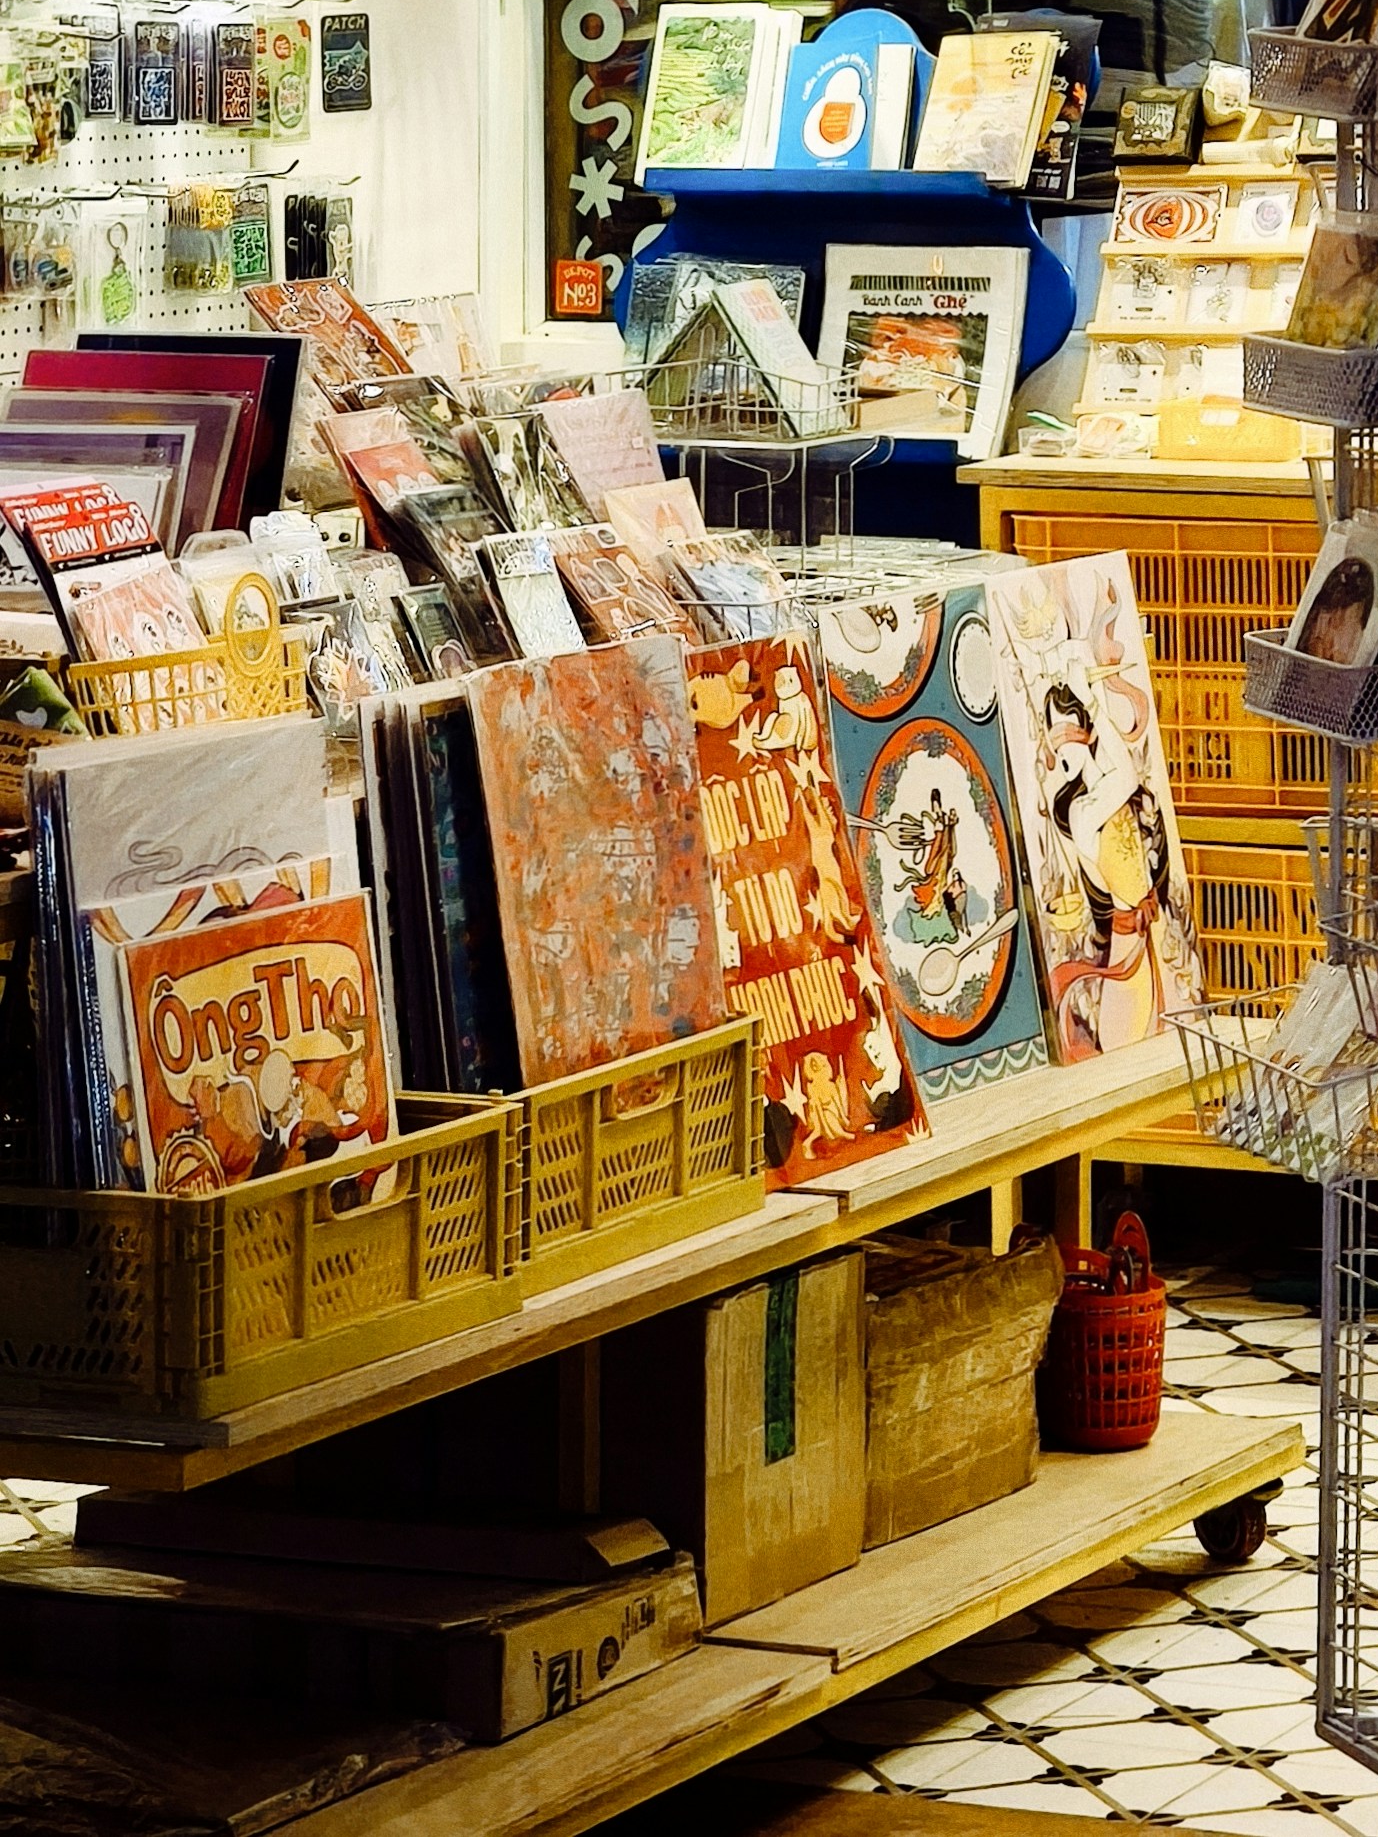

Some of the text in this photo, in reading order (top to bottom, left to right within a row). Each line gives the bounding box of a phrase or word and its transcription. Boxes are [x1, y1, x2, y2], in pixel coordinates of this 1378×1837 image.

[324, 15, 367, 33] PATCH
[39, 523, 99, 559] FUNNY
[762, 867, 804, 940] DO
